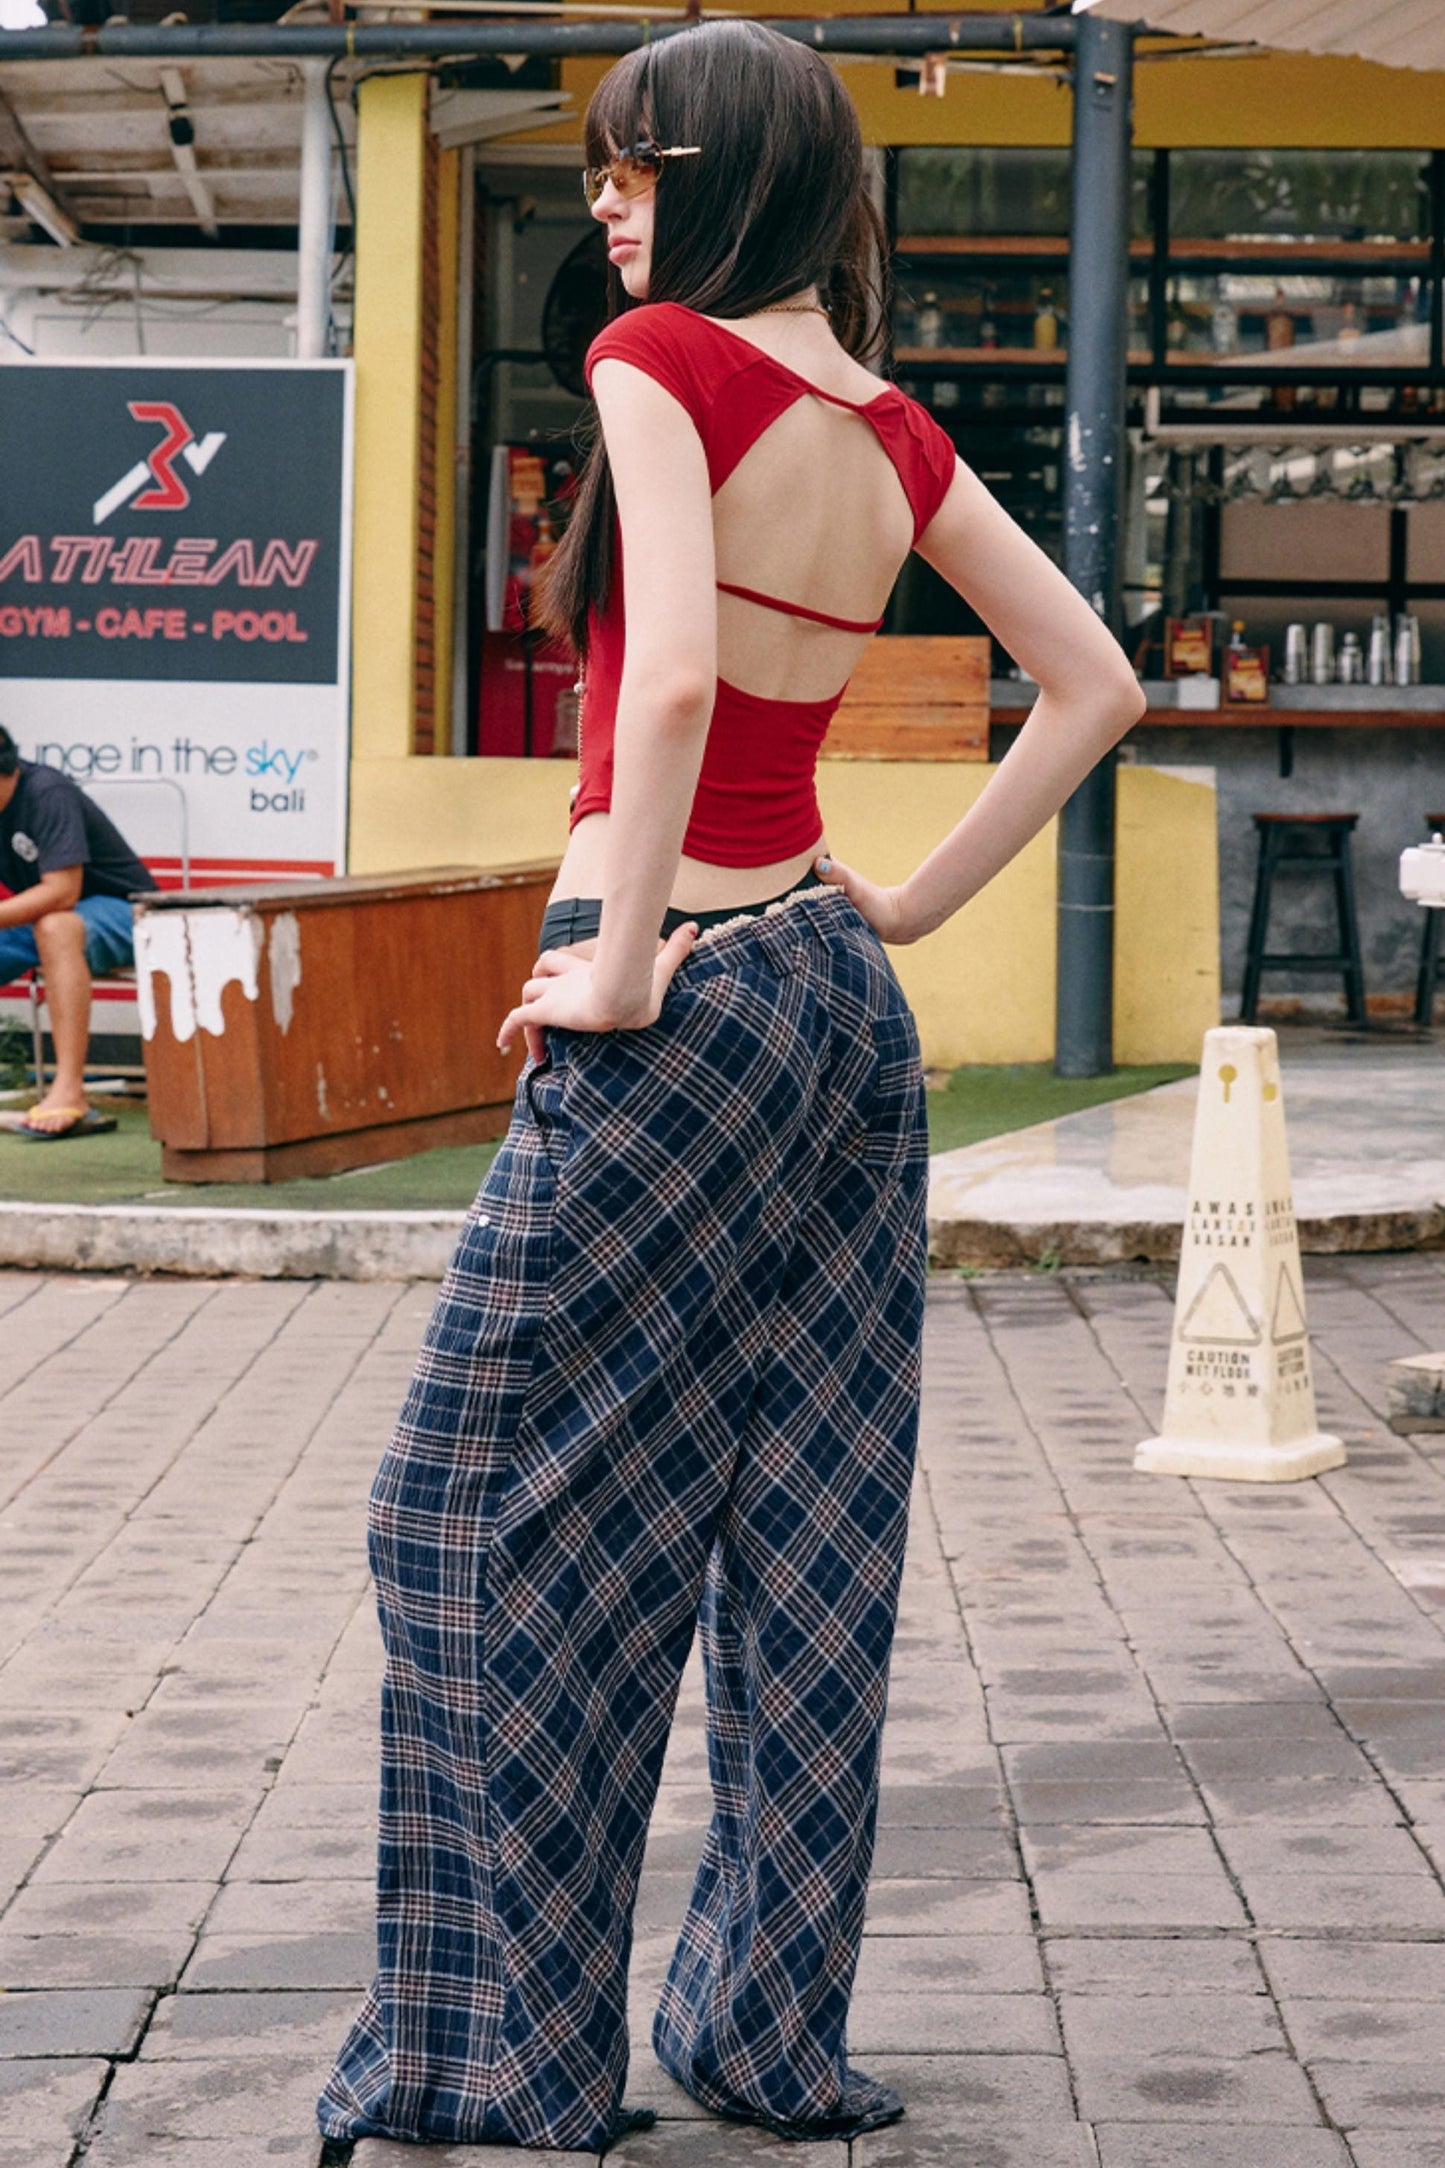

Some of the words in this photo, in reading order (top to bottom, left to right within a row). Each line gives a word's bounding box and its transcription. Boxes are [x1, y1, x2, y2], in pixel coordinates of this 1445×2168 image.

[0, 535, 319, 587] ATHLEAN
[0, 606, 71, 637] GYM
[95, 607, 188, 639] CAFE
[211, 609, 308, 642] POOL
[130, 736, 162, 774] in
[171, 737, 238, 776] the
[250, 788, 306, 813] bali
[1192, 1200, 1254, 1216] AWAS
[1187, 1350, 1250, 1365] CAUTION
